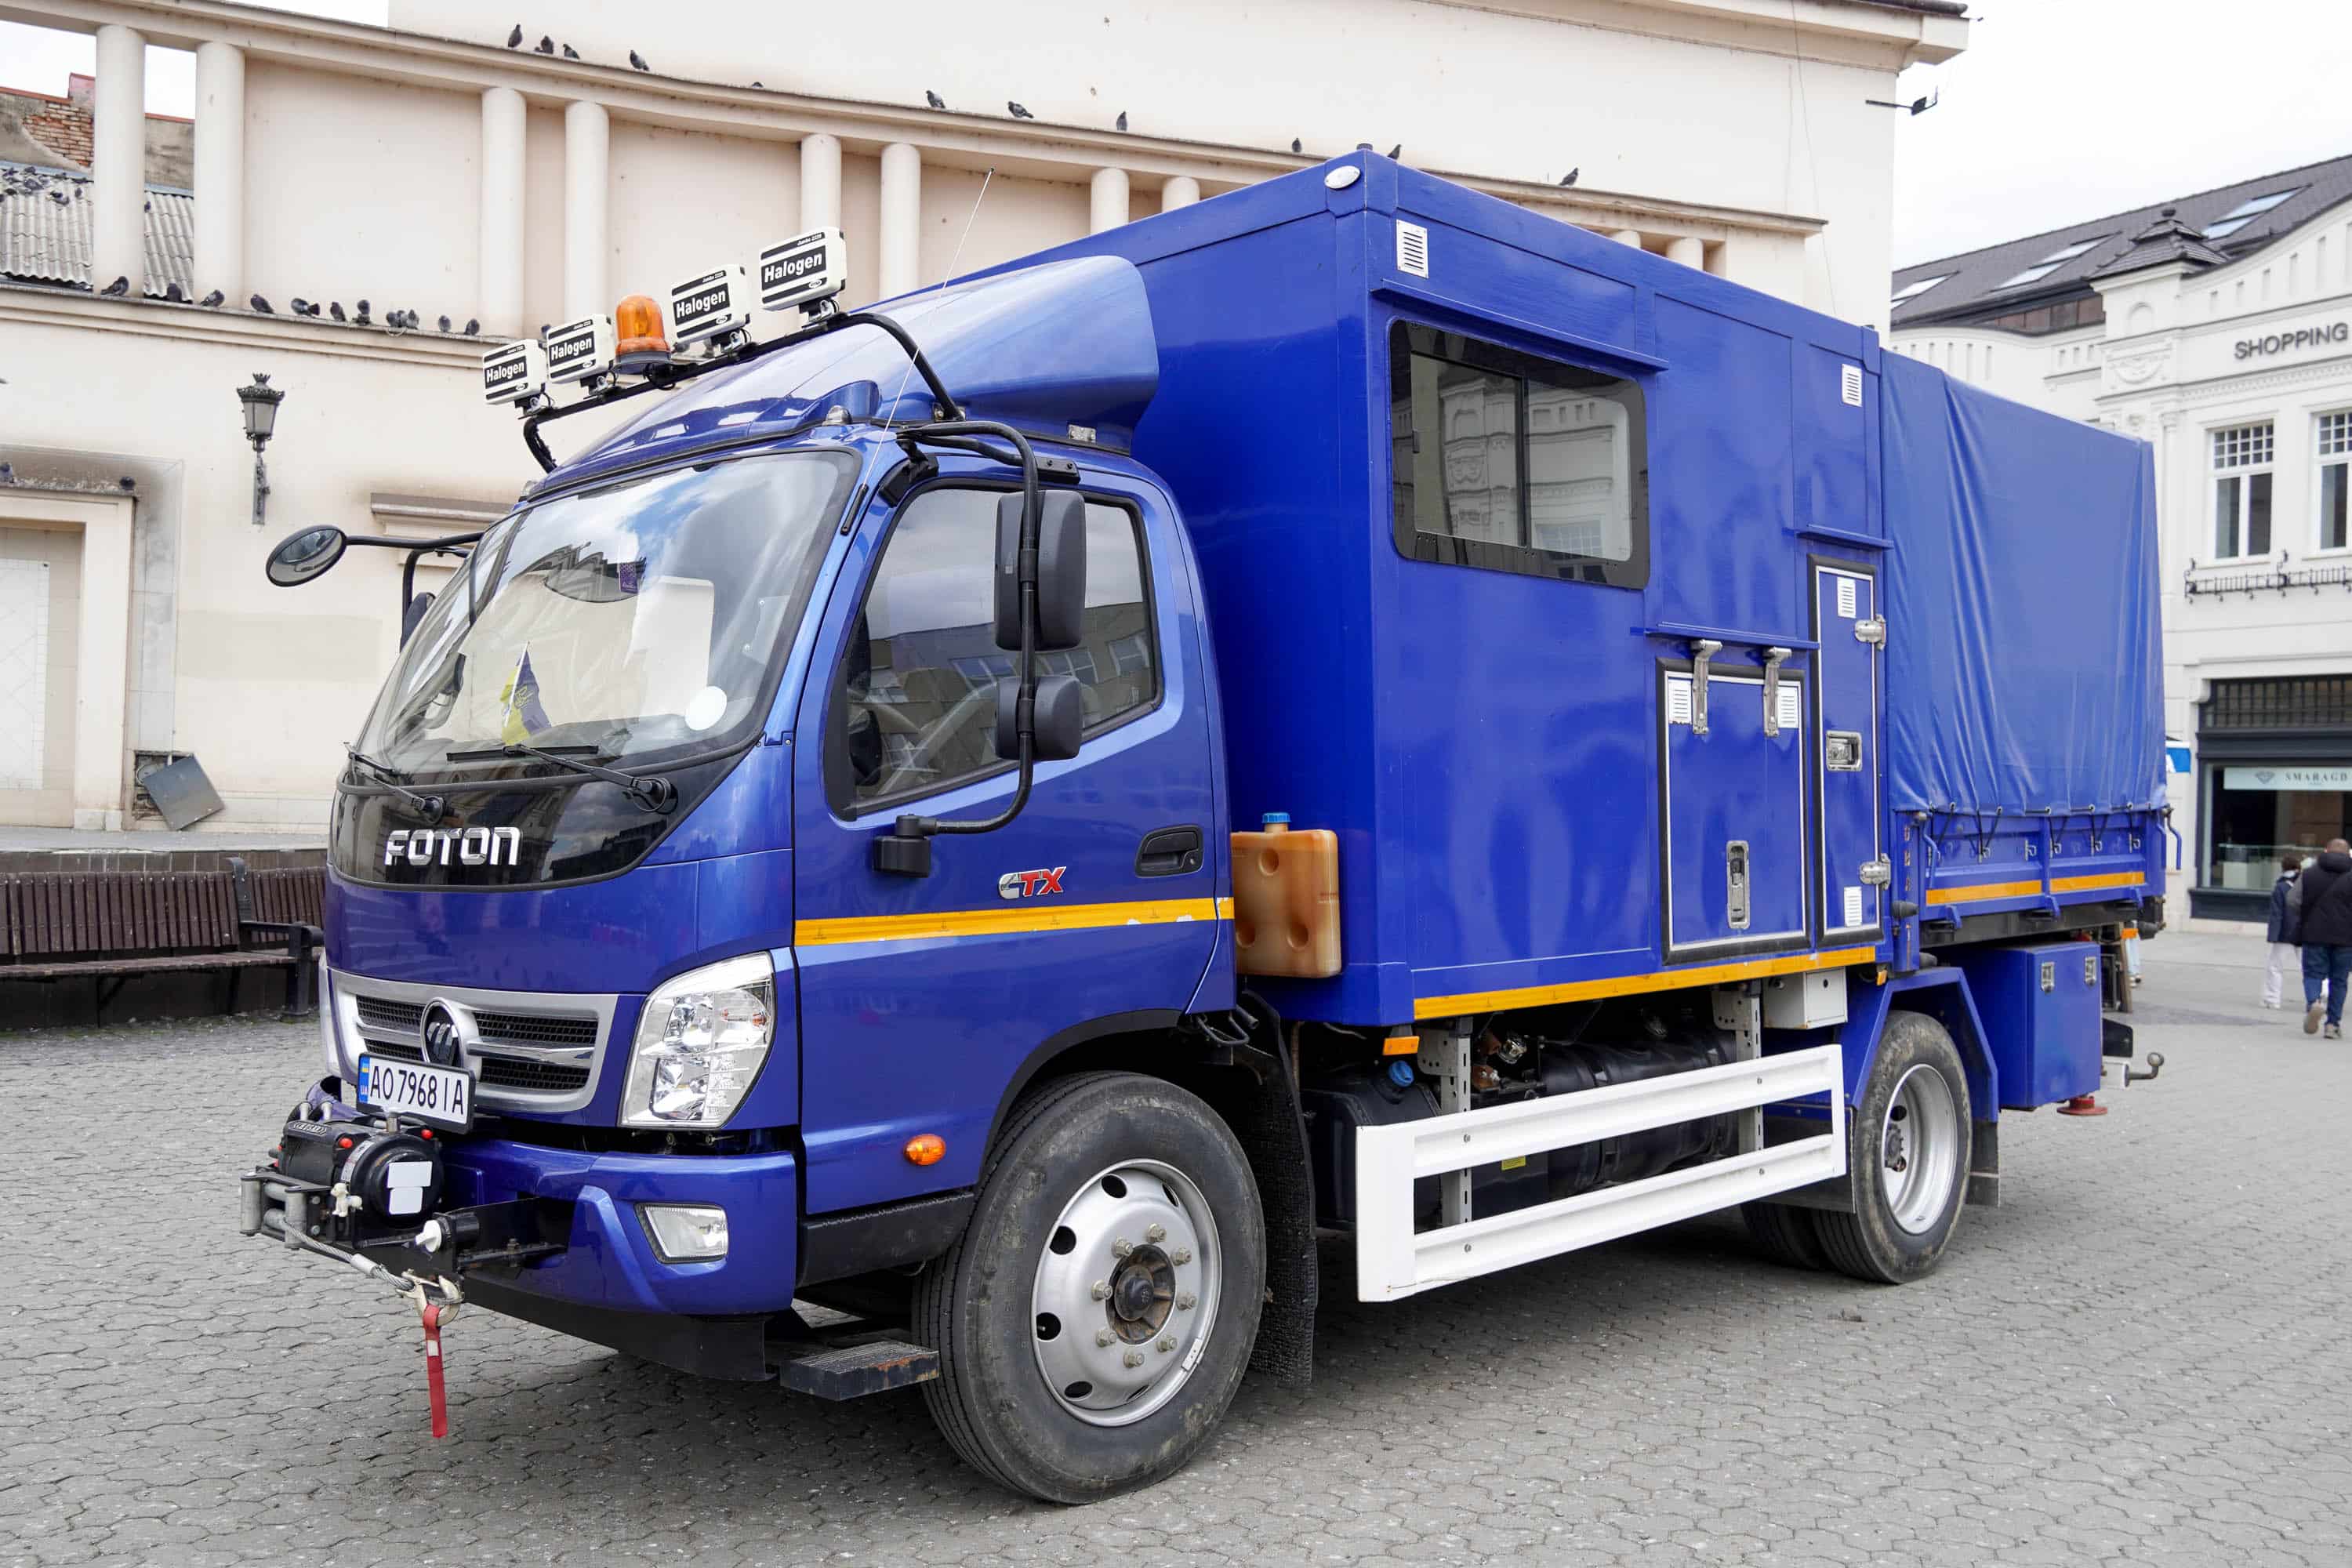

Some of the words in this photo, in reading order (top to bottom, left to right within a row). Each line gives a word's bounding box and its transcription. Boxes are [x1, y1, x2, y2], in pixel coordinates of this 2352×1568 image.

[764, 252, 822, 283] Halogen
[676, 290, 726, 318] Halogen
[551, 337, 592, 361] Halogen
[2234, 322, 2348, 360] SHOPPING
[486, 361, 524, 383] Halogen
[2285, 771, 2348, 782] SMARAGD
[384, 826, 522, 866] FOTON
[370, 1065, 394, 1100] AO
[397, 1069, 437, 1109] 7968
[444, 1077, 464, 1115] IA
